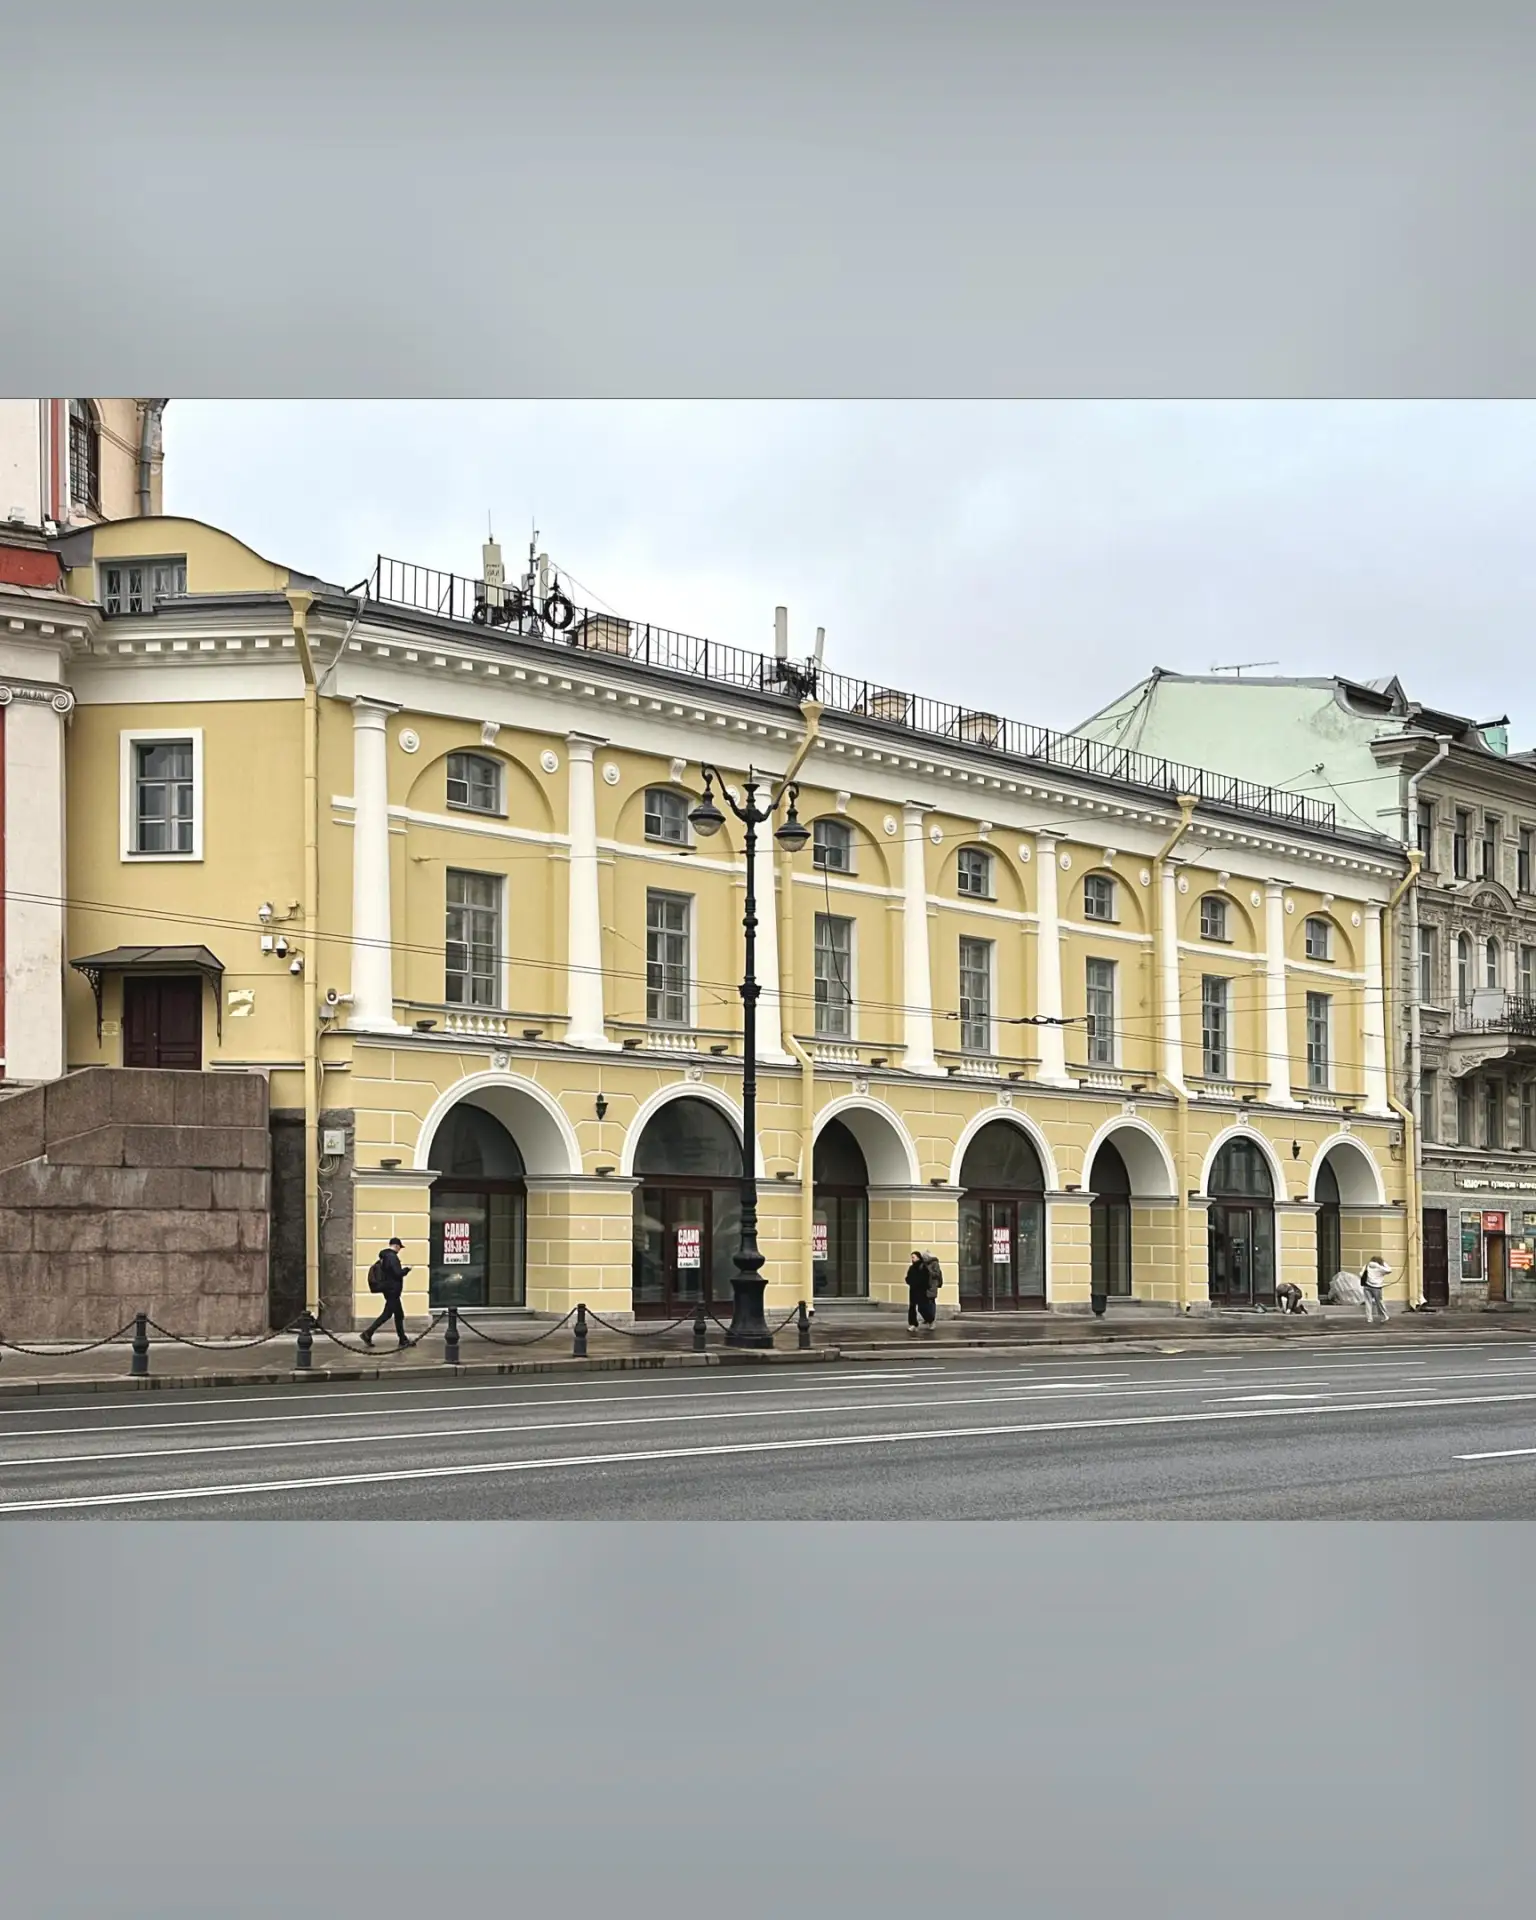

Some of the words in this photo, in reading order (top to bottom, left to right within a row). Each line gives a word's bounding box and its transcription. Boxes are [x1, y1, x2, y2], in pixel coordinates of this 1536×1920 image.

[444, 1223, 470, 1240] СДАНО
[678, 1229, 700, 1245] СДАНО
[812, 1225, 827, 1240] ДАНО
